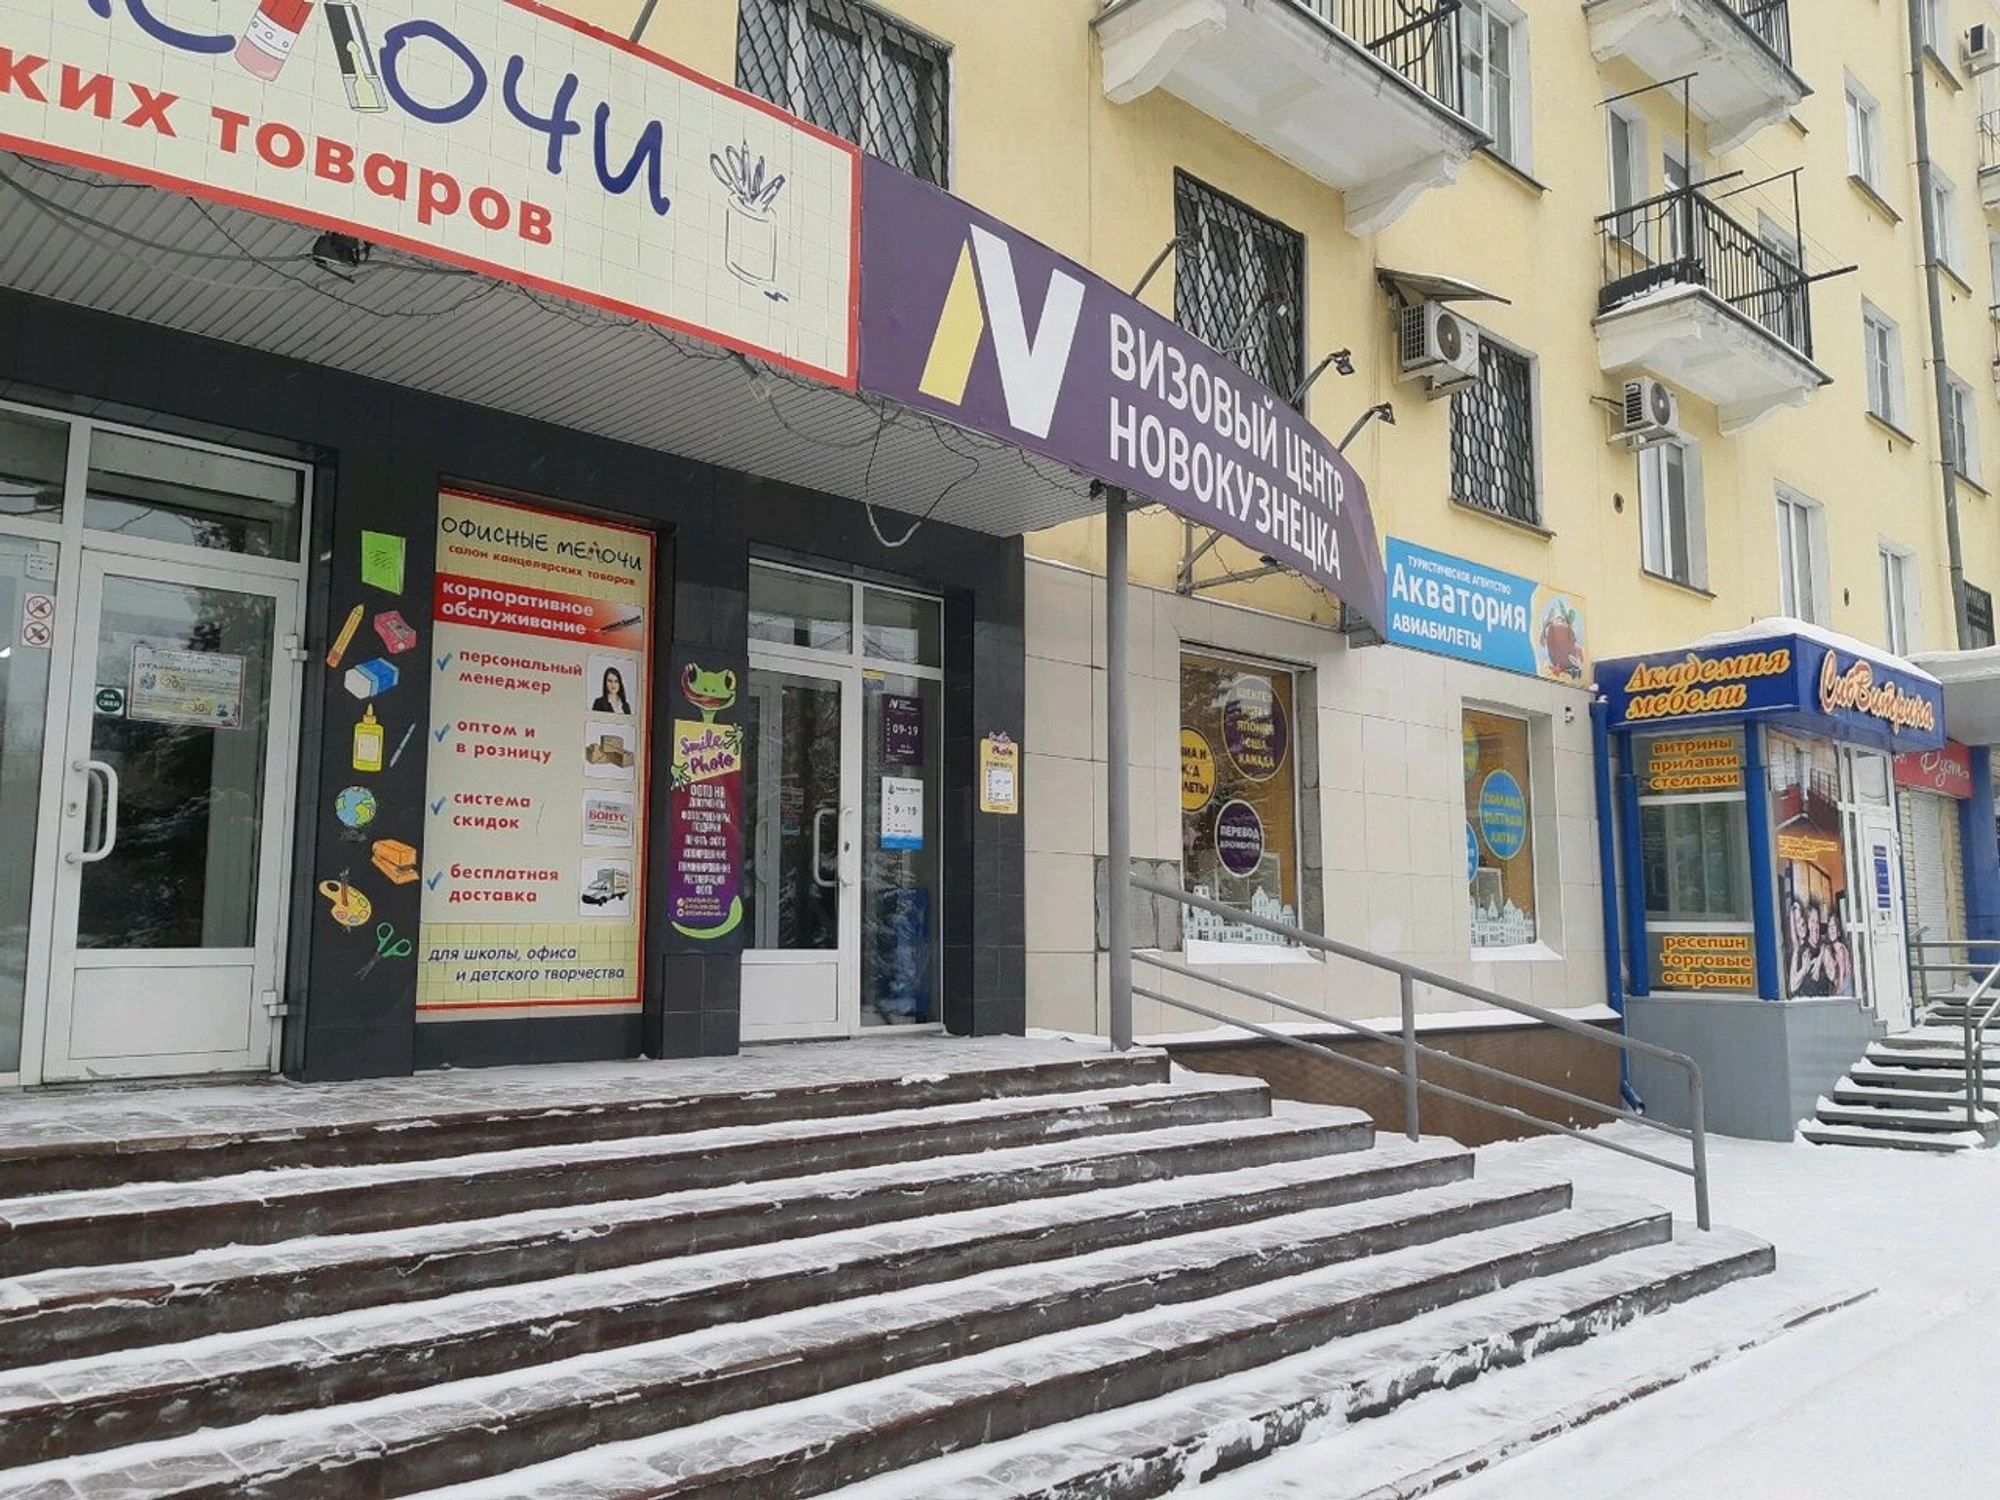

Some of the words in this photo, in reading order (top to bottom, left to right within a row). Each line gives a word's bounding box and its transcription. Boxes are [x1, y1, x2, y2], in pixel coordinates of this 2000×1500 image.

[211, 106, 555, 246] товаров
[1109, 311, 1277, 464] ВИЗОВЫЙ
[1284, 425, 1345, 513] ЦЕНТР
[1109, 398, 1342, 582] НОВОКУЗНЕЦКА
[441, 517, 549, 552] ОФИСНЫЕ
[448, 544, 488, 559] салон
[493, 552, 582, 577] канцелярских
[587, 570, 636, 586] товаров
[1407, 554, 1471, 585] ТУРИСТИЧЕСКОЕ
[1471, 574, 1512, 595] АГЕНТСТВО
[442, 580, 594, 617] корпоративное
[1392, 562, 1527, 633] Акватория
[442, 601, 587, 635] обслуживание
[1392, 612, 1482, 651] АВИАБИЛЕТЫ
[459, 650, 583, 677] персональный
[1625, 646, 1790, 693] Академия
[459, 672, 552, 695] менеджер
[1626, 681, 1747, 720] мебели
[456, 720, 518, 737] оптом
[525, 727, 536, 738] и
[679, 728, 725, 756] Smile
[1652, 737, 1734, 756] витрины
[456, 743, 467, 753] в
[474, 743, 552, 765] розницу
[690, 752, 734, 775] Photo
[1649, 754, 1739, 774] прилавки
[1649, 772, 1740, 790] стеллажи
[453, 792, 531, 808] система
[452, 814, 520, 831] скидок
[588, 810, 628, 823] БОНУС
[1219, 824, 1260, 840] ПЕРЕВОД
[450, 863, 559, 881] бесплатная
[449, 888, 538, 904] доставка
[428, 948, 459, 961] для
[464, 945, 521, 962] школы,
[527, 946, 577, 962] офиса
[1662, 935, 1747, 953] ресепшн
[1660, 953, 1752, 971] торговые
[456, 972, 466, 981] и
[469, 967, 539, 983] детского
[545, 966, 625, 983] творчества
[1661, 971, 1752, 989] островки
